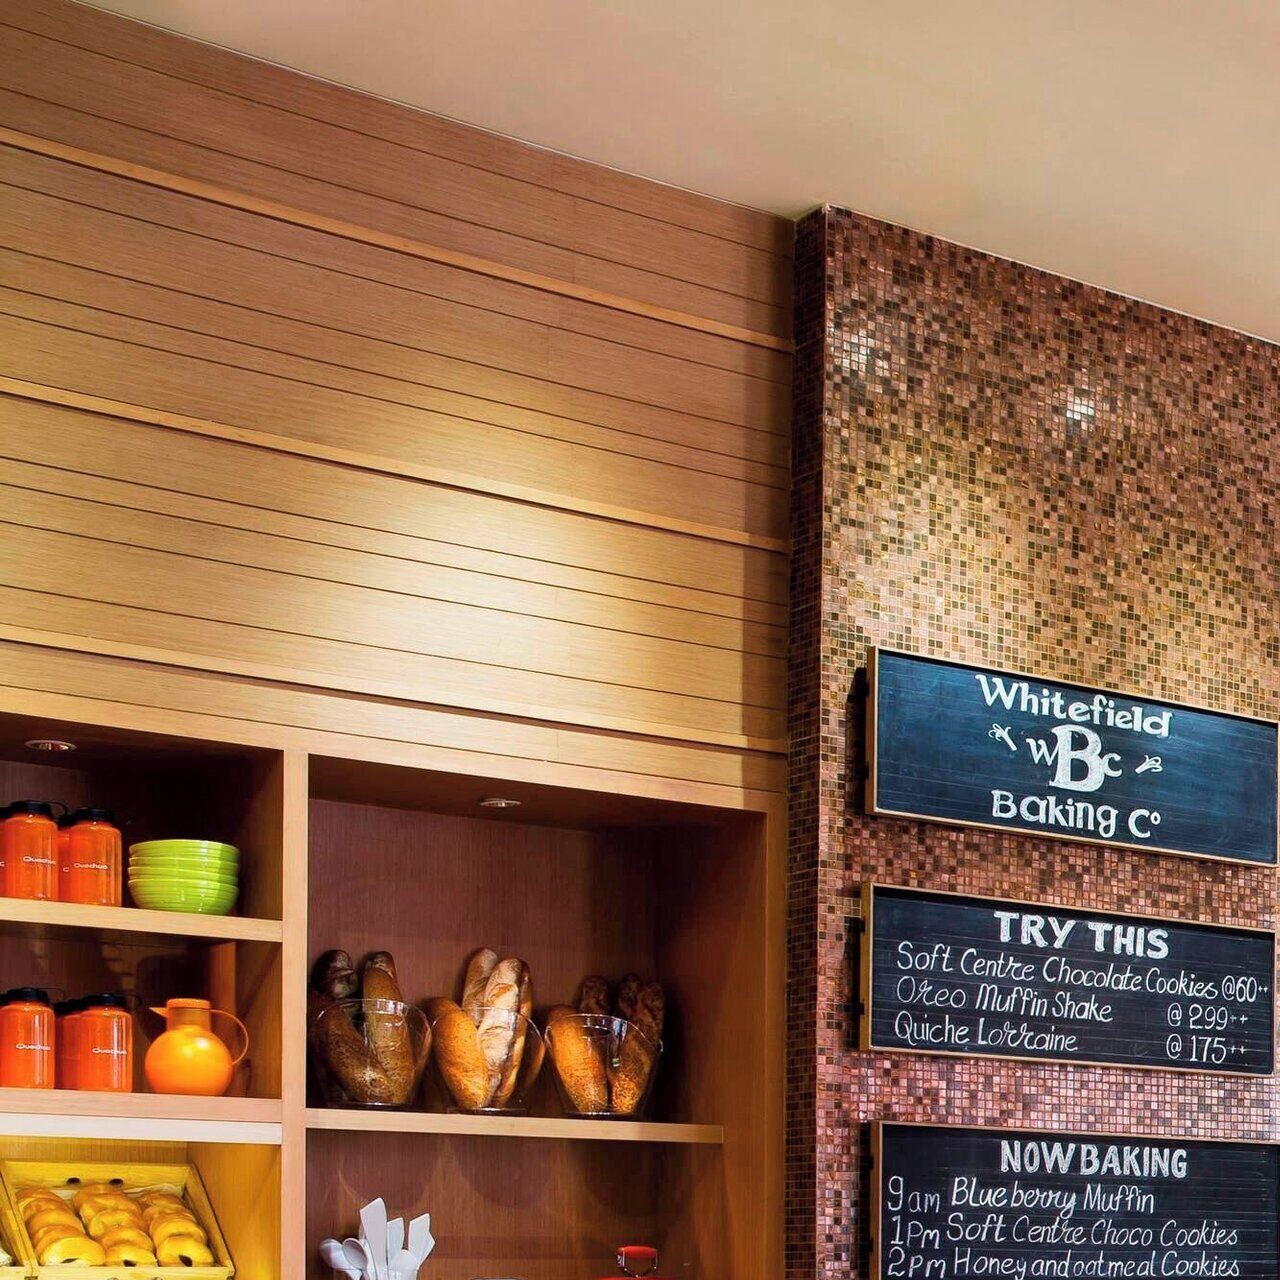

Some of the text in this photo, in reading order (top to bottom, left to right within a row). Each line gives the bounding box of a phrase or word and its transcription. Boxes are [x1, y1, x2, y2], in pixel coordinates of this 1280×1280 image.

[975, 674, 1174, 738] Whitefield
[1026, 724, 1123, 792] WBC
[991, 790, 1118, 838] Baking
[994, 911, 1169, 959] TRY THIS
[897, 942, 952, 971] Soft
[961, 949, 1035, 981] Centre
[1043, 957, 1141, 991] Chocolate
[1147, 968, 1218, 999] Cookies
[897, 976, 966, 1008] Oreo
[976, 984, 1048, 1018] Muffin
[1052, 991, 1112, 1022] Shake
[895, 1011, 969, 1045] Quiche
[978, 1019, 1078, 1052] Lorraine
[1000, 1140, 1187, 1178] NOW BAKING
[1083, 1184, 1154, 1213] Muffin
[946, 1213, 1006, 1243] Soft
[1013, 1216, 1087, 1246] Centre
[1091, 1221, 1153, 1247] Choco
[1160, 1221, 1238, 1247] Cookies
[1031, 1250, 1069, 1278] and
[1074, 1251, 1156, 1277] oatmeal
[1160, 1252, 1240, 1278] Cookies
